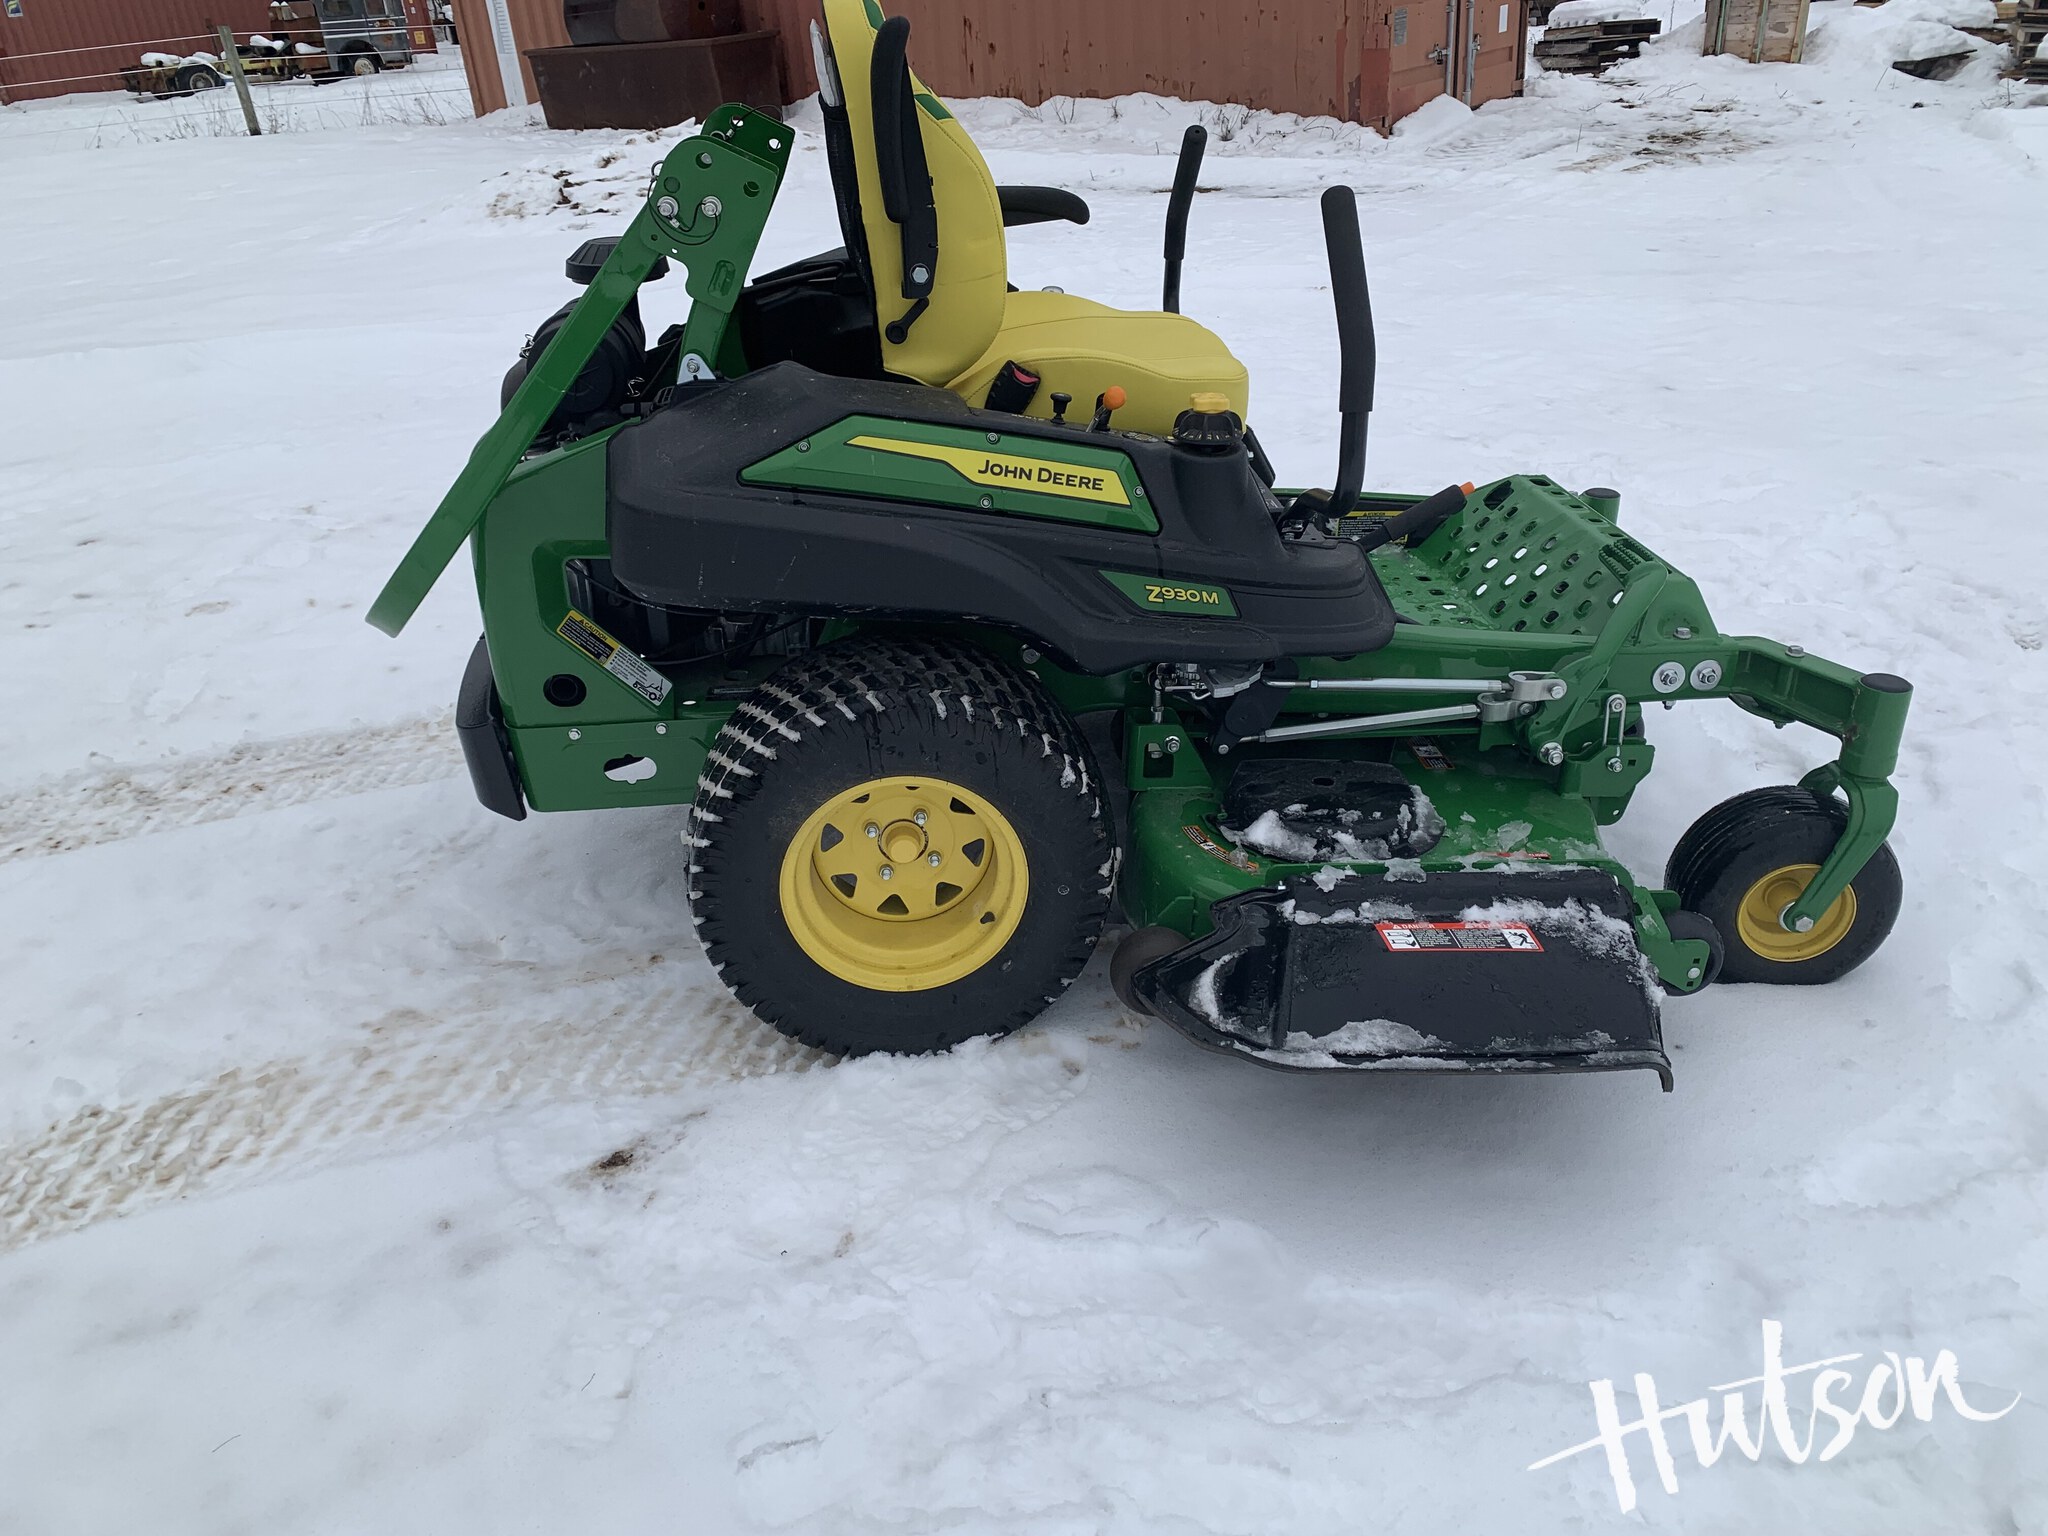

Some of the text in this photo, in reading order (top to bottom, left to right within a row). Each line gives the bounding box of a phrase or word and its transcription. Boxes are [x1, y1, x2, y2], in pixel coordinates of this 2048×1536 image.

[978, 459, 1105, 491] JOHN DEERE
[1145, 585, 1219, 604] Z930M
[584, 622, 608, 641] CAUTION
